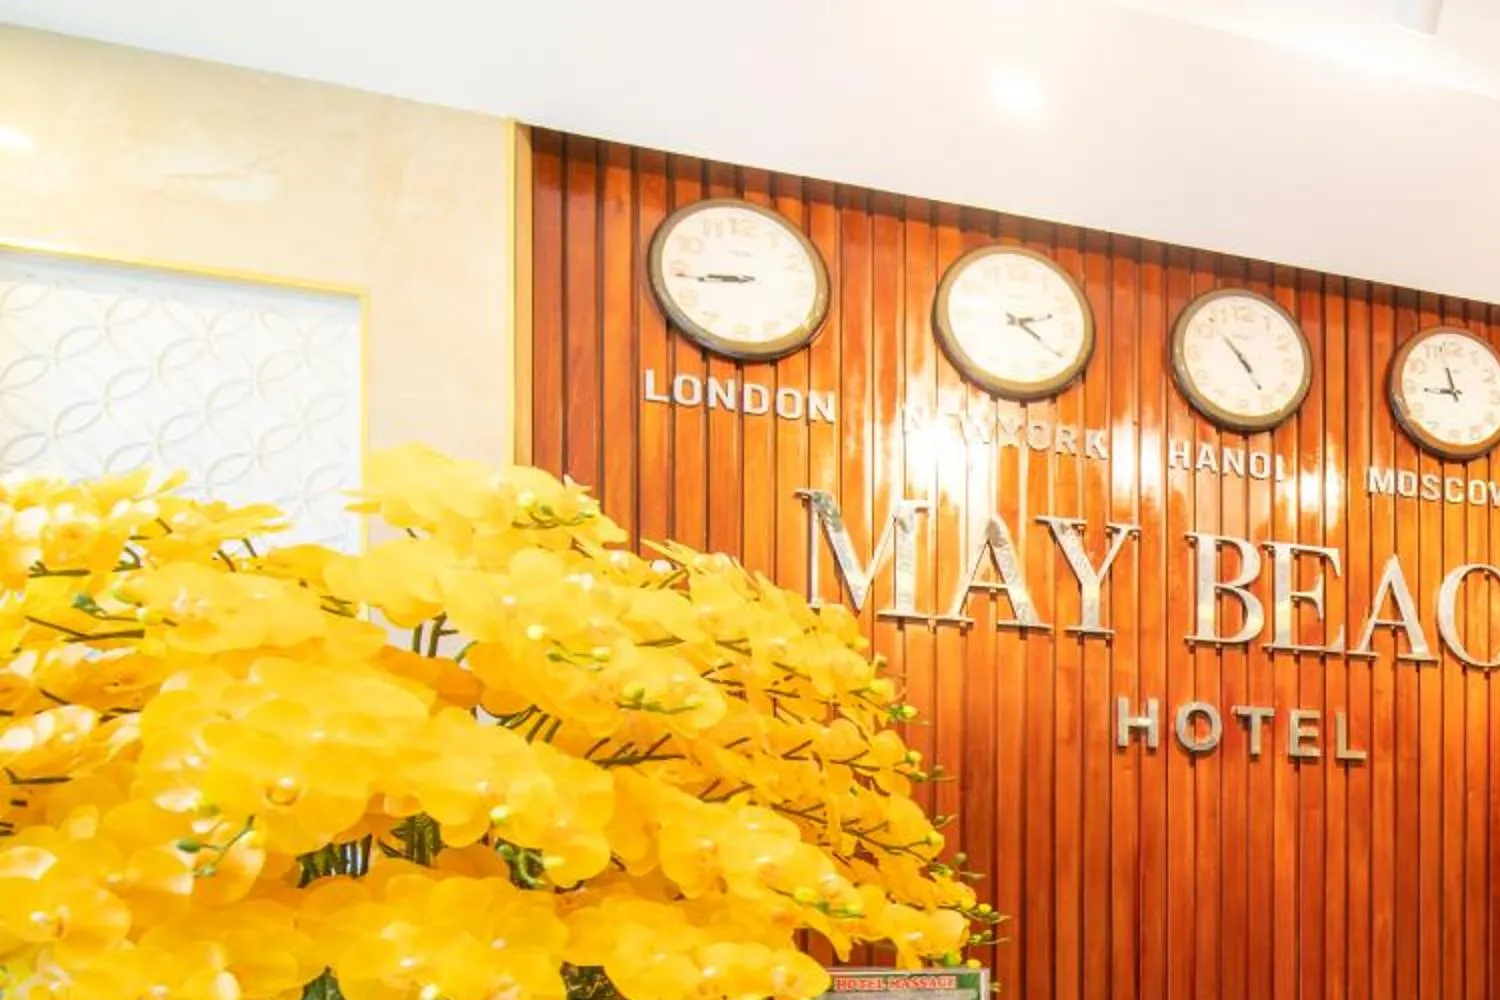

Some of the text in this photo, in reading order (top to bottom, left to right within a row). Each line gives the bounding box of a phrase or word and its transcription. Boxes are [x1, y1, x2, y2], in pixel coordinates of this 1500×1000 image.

[644, 369, 836, 424] LONDON
[995, 409, 1109, 460] YORK
[1167, 440, 1285, 483] HANOI
[794, 489, 1142, 639] MAY
[1117, 696, 1367, 759] HOTEL
